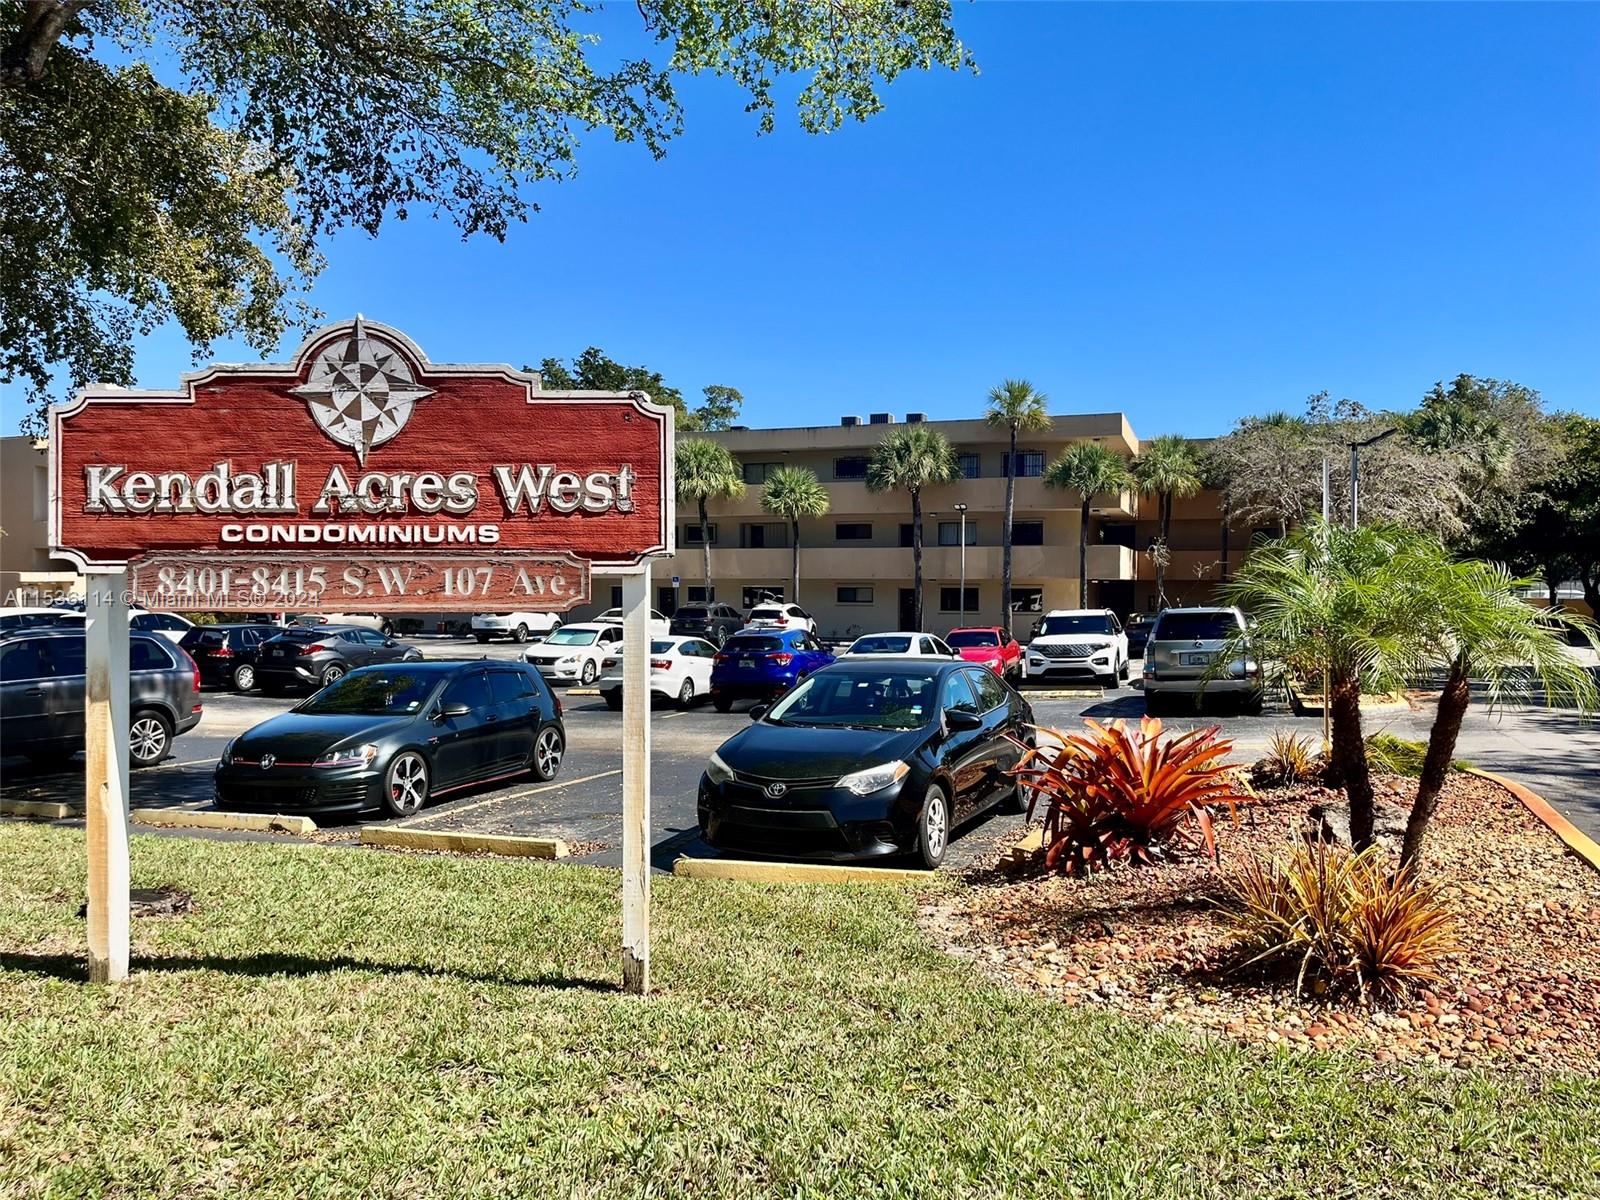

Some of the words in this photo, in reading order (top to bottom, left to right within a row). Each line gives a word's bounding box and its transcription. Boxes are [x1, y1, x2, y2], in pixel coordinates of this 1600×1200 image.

[84, 459, 298, 513] Kendall
[312, 463, 479, 513] Acres
[494, 463, 637, 513] West
[220, 524, 500, 543] CONDOMINIUMS
[158, 566, 328, 596] 8401-8415
[342, 567, 424, 596] S.W.
[442, 567, 493, 596] 107
[509, 567, 577, 596] Ave.
